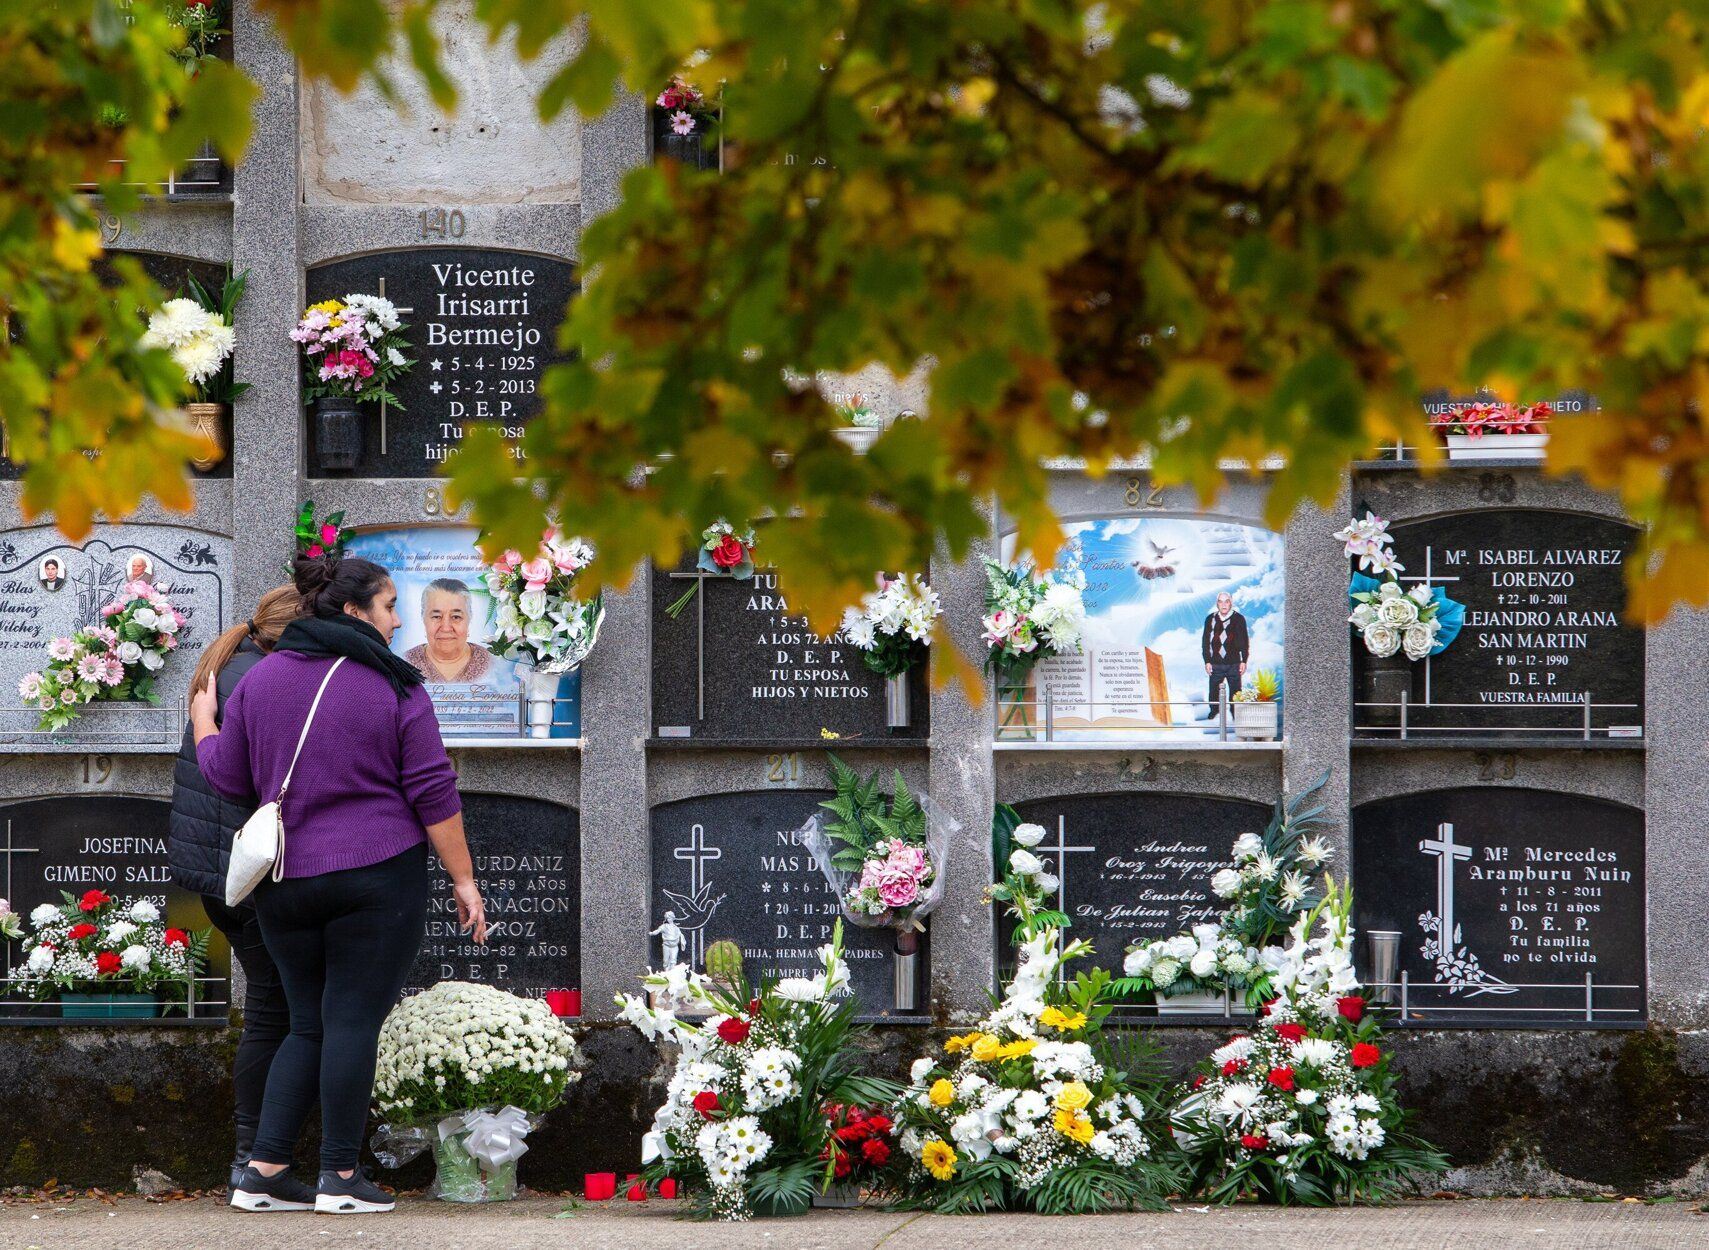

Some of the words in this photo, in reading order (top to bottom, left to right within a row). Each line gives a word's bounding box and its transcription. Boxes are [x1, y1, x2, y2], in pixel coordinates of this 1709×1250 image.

[418, 209, 465, 238] 140
[432, 263, 535, 286] Vicente
[437, 292, 530, 316] Irisarri
[427, 322, 540, 351] Bermejo
[451, 357, 460, 371] 5
[475, 357, 484, 371] 4
[500, 357, 535, 371] 1925
[451, 380, 460, 394] 5
[475, 380, 484, 394] 2
[500, 380, 535, 394] 2013
[450, 402, 470, 417] D.
[476, 402, 494, 417] E.
[500, 402, 517, 417] P.
[440, 423, 463, 439] Tu
[1478, 550, 1538, 565] ISABEL
[1542, 550, 1622, 565] ALVAREZ
[1492, 572, 1574, 587] LORENZO
[1, 580, 36, 594] Blas
[1507, 594, 1520, 604] 22
[1529, 594, 1540, 604] 10
[1548, 594, 1568, 604] 2011
[780, 616, 788, 628] 5
[801, 616, 808, 628] 3
[1462, 612, 1550, 626] LEJANDRO
[1554, 612, 1618, 626] ARANA
[758, 634, 768, 644] A
[772, 634, 800, 644] LOS
[806, 634, 820, 644] 72
[824, 631, 853, 644] AÑO
[1478, 634, 1513, 648] SAN
[1518, 634, 1588, 648] MARTIN
[777, 650, 794, 664] D.
[804, 650, 820, 664] E.
[831, 650, 844, 664] P.
[1506, 656, 1516, 666] 10
[1526, 656, 1536, 666] 12
[1546, 656, 1568, 666] 1990
[770, 670, 788, 680] TU
[794, 670, 850, 680] ESPOSA
[1509, 672, 1522, 685] D.
[1528, 672, 1540, 685] E.
[1548, 672, 1556, 685] P.
[752, 686, 796, 698] HIJOS
[800, 686, 809, 698] Y
[814, 686, 868, 698] NIETOS
[1480, 692, 1537, 702] VUESTRA
[1538, 692, 1585, 702] FAMILIA
[80, 756, 112, 784] 19
[768, 752, 798, 782] 21
[80, 838, 168, 854] JOSEFINA
[1134, 841, 1208, 852] Andrea
[1525, 847, 1617, 862] Mercedes
[476, 856, 564, 871] URDANIZ
[760, 856, 799, 872] MAS
[1105, 856, 1146, 872] Oroz
[1155, 856, 1240, 873] Irigoyen
[44, 866, 116, 882] GIMENO
[126, 866, 172, 882] SALD
[1470, 866, 1572, 881] Aramburu
[1584, 866, 1631, 883] Nuin
[526, 876, 566, 890] AÑOS
[782, 882, 788, 893] 8
[804, 882, 810, 893] 6
[1140, 888, 1206, 900] Eusebio
[1517, 886, 1528, 896] 11
[1548, 886, 1556, 896] 8
[1574, 886, 1602, 896] 2011
[776, 904, 789, 914] 20
[804, 904, 813, 914] 11
[1076, 904, 1102, 916] De
[1104, 904, 1170, 920] Julian
[1500, 903, 1508, 912] a
[1516, 901, 1538, 912] los
[1546, 903, 1558, 912] 71
[1567, 902, 1600, 914] años
[1510, 916, 1528, 931] D.
[1542, 916, 1562, 931] E.
[1575, 916, 1590, 931] P.
[777, 925, 792, 939] D.
[800, 925, 812, 939] E.
[528, 942, 568, 956] AÑOS
[1510, 936, 1528, 946] Tu
[1537, 936, 1590, 948] familia
[744, 949, 772, 960] HIJA,
[844, 950, 884, 958] PADRES
[1503, 952, 1520, 963] no
[1528, 952, 1542, 963] te
[1550, 952, 1597, 963] olvida
[440, 964, 458, 980] D.
[470, 964, 486, 980] E.
